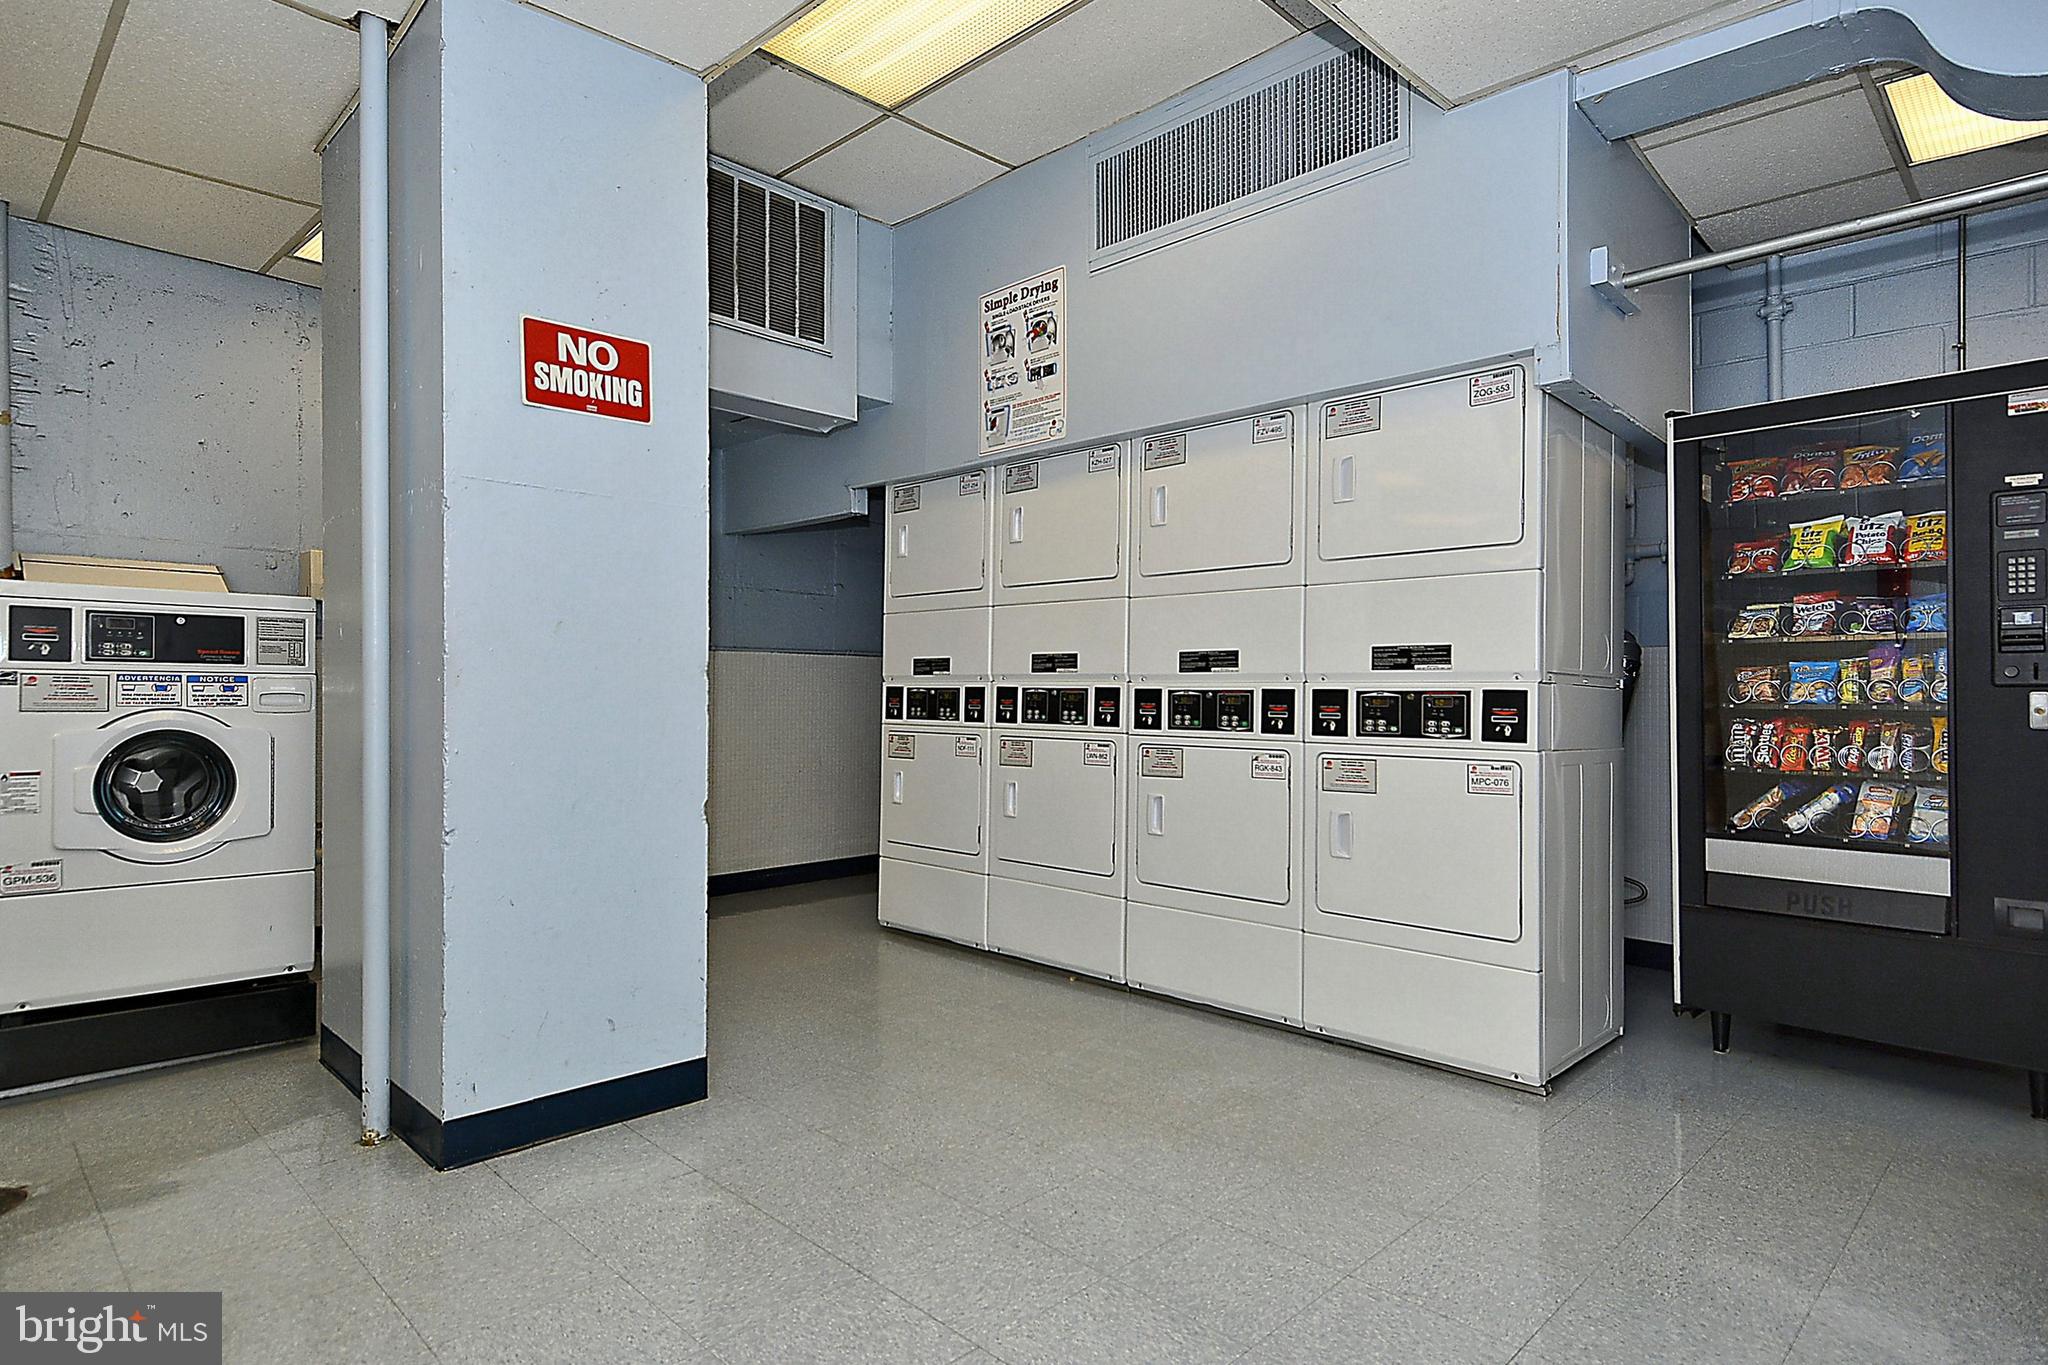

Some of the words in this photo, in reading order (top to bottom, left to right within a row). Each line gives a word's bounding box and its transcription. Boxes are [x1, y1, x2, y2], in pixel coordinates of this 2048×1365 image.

[984, 291, 1018, 313] Simple
[1020, 279, 1059, 300] Drying
[557, 332, 619, 372] NO
[533, 361, 643, 408] SMOKING
[1793, 450, 1836, 460] Doritos
[1855, 531, 1886, 539] Potato
[1796, 602, 1834, 614] Welch's
[1757, 723, 1774, 764] Skittles
[1471, 777, 1510, 787] MPC-076
[2, 874, 57, 886] GPM-536
[1786, 893, 1853, 916] PUSH
